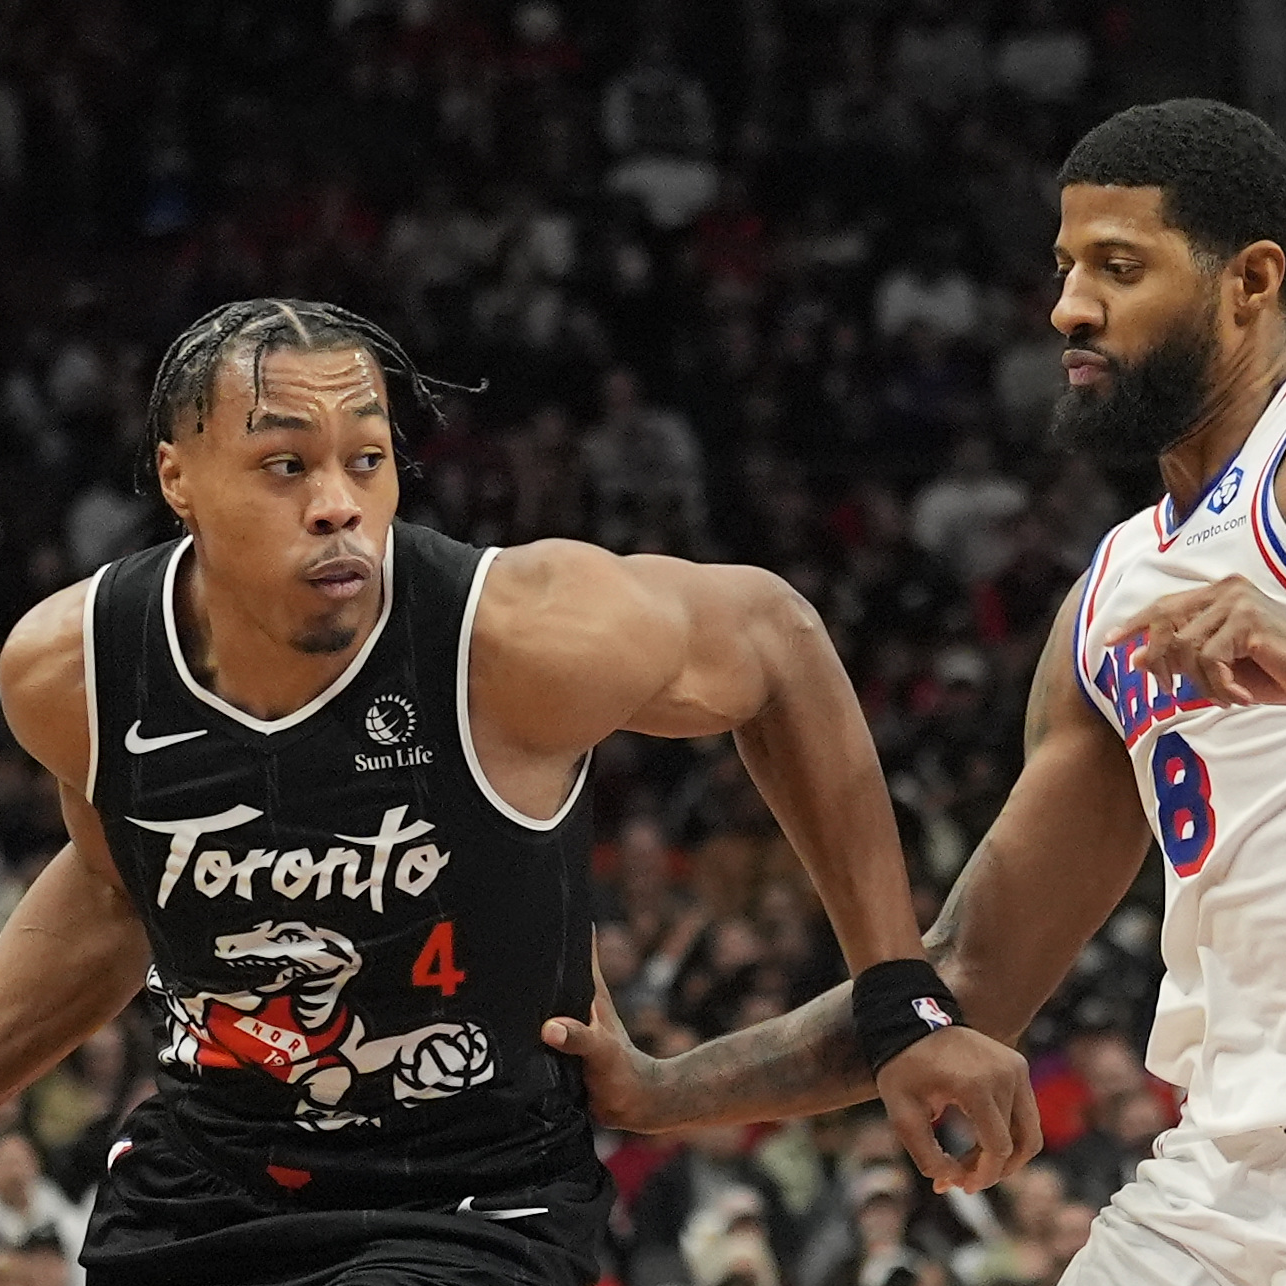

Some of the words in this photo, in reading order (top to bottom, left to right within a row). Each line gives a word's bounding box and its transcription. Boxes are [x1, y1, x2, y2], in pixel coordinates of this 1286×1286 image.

[1185, 514, 1247, 546] crypto.com
[354, 753, 394, 772] Sun
[396, 745, 434, 767] Life
[1151, 731, 1216, 878] 8
[123, 803, 451, 914] Toronto
[411, 921, 466, 997] 4
